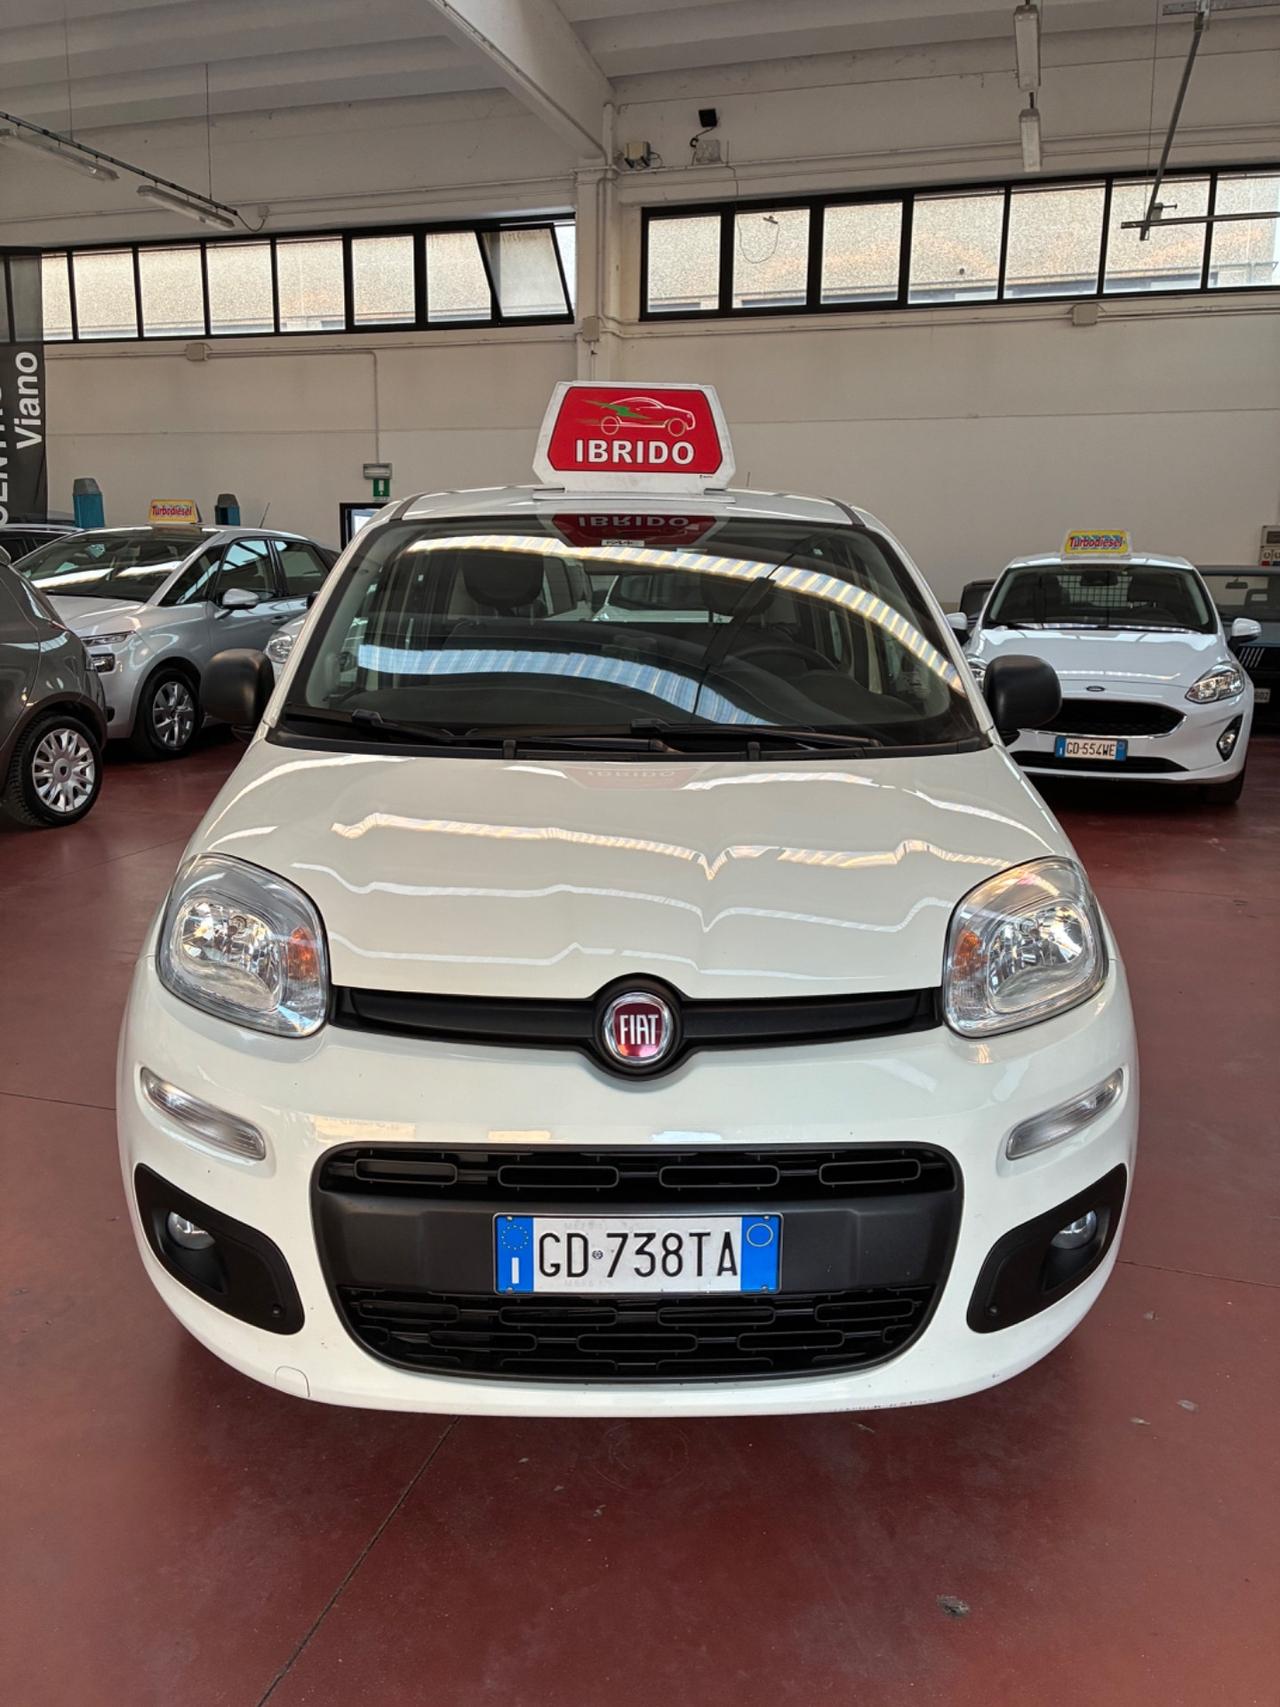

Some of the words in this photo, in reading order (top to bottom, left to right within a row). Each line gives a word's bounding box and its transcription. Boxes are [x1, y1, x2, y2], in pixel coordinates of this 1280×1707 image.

[13, 352, 43, 449] Viano
[576, 439, 695, 465] IBRIDO
[151, 505, 193, 516] Turbodiesel
[1069, 534, 1123, 547] Turbodiesel
[619, 1013, 659, 1046] FIAT
